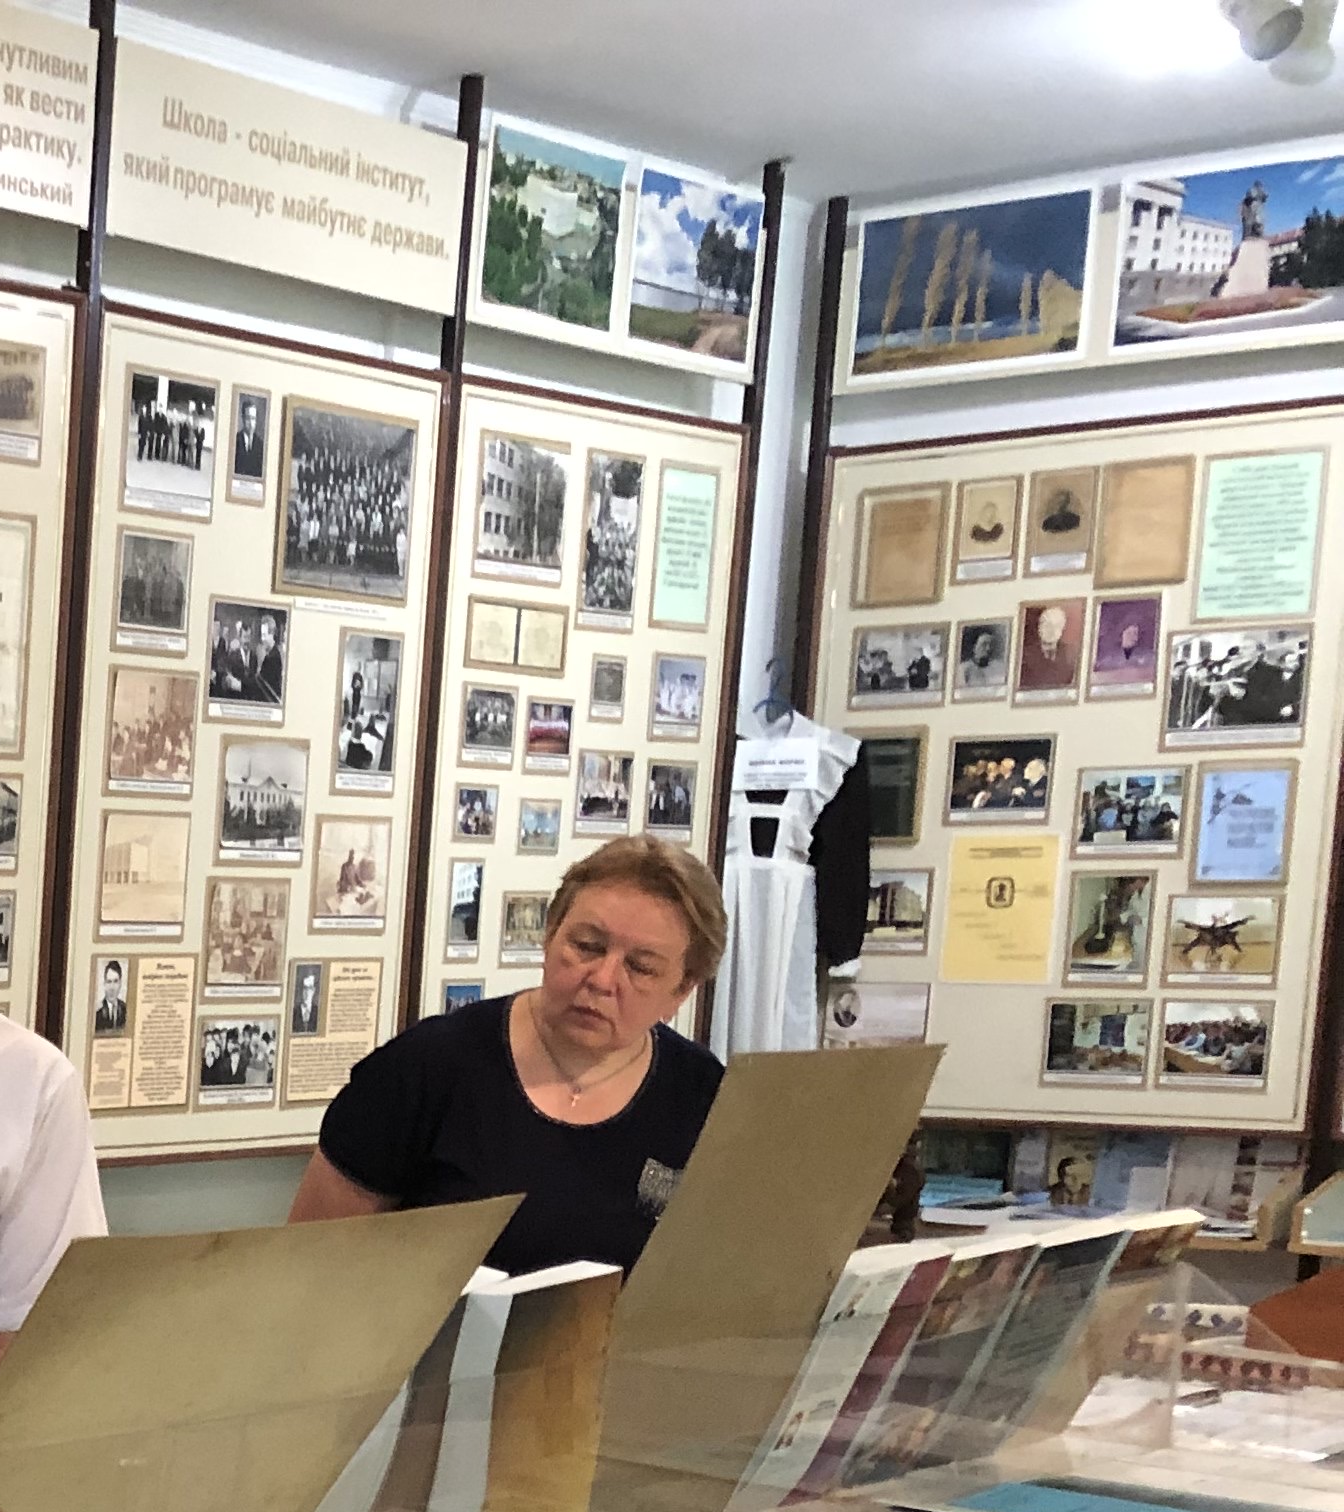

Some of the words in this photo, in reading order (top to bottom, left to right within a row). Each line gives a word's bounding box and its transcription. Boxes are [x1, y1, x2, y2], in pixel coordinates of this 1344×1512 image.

[3, 83, 24, 106] як
[29, 91, 86, 124] вести
[161, 96, 227, 144] Школа
[248, 127, 351, 178] соціальний
[356, 153, 430, 207] інститут,
[123, 151, 170, 187] який
[173, 166, 275, 218] програмує
[281, 195, 367, 239] майбутнє
[370, 219, 450, 260] держави.
